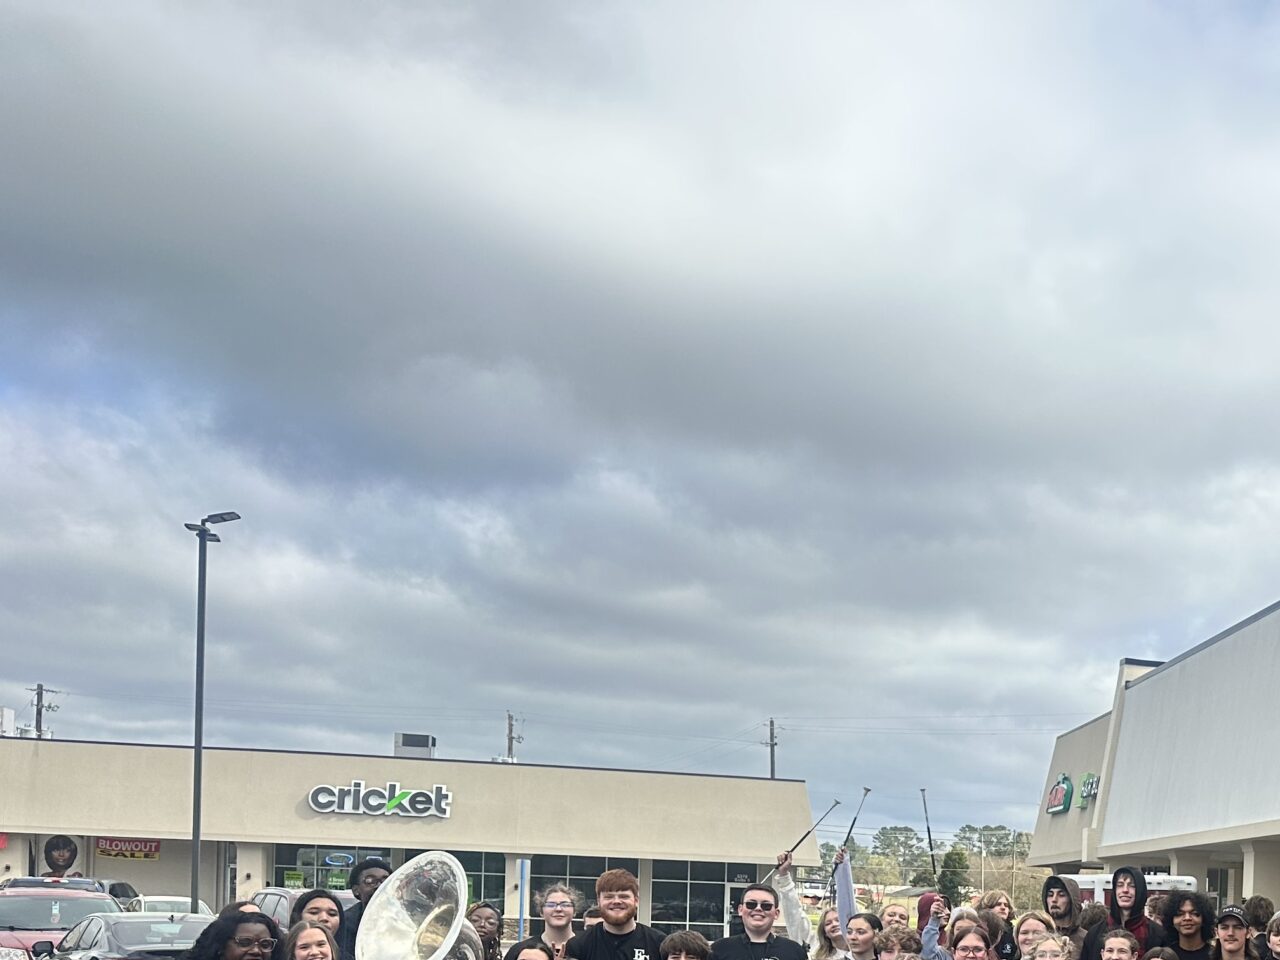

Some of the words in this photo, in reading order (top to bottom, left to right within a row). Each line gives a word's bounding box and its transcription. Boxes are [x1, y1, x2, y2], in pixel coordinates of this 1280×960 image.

[310, 781, 451, 817] cricket
[98, 839, 158, 852] BLOWOUT
[97, 849, 157, 859] SALE
